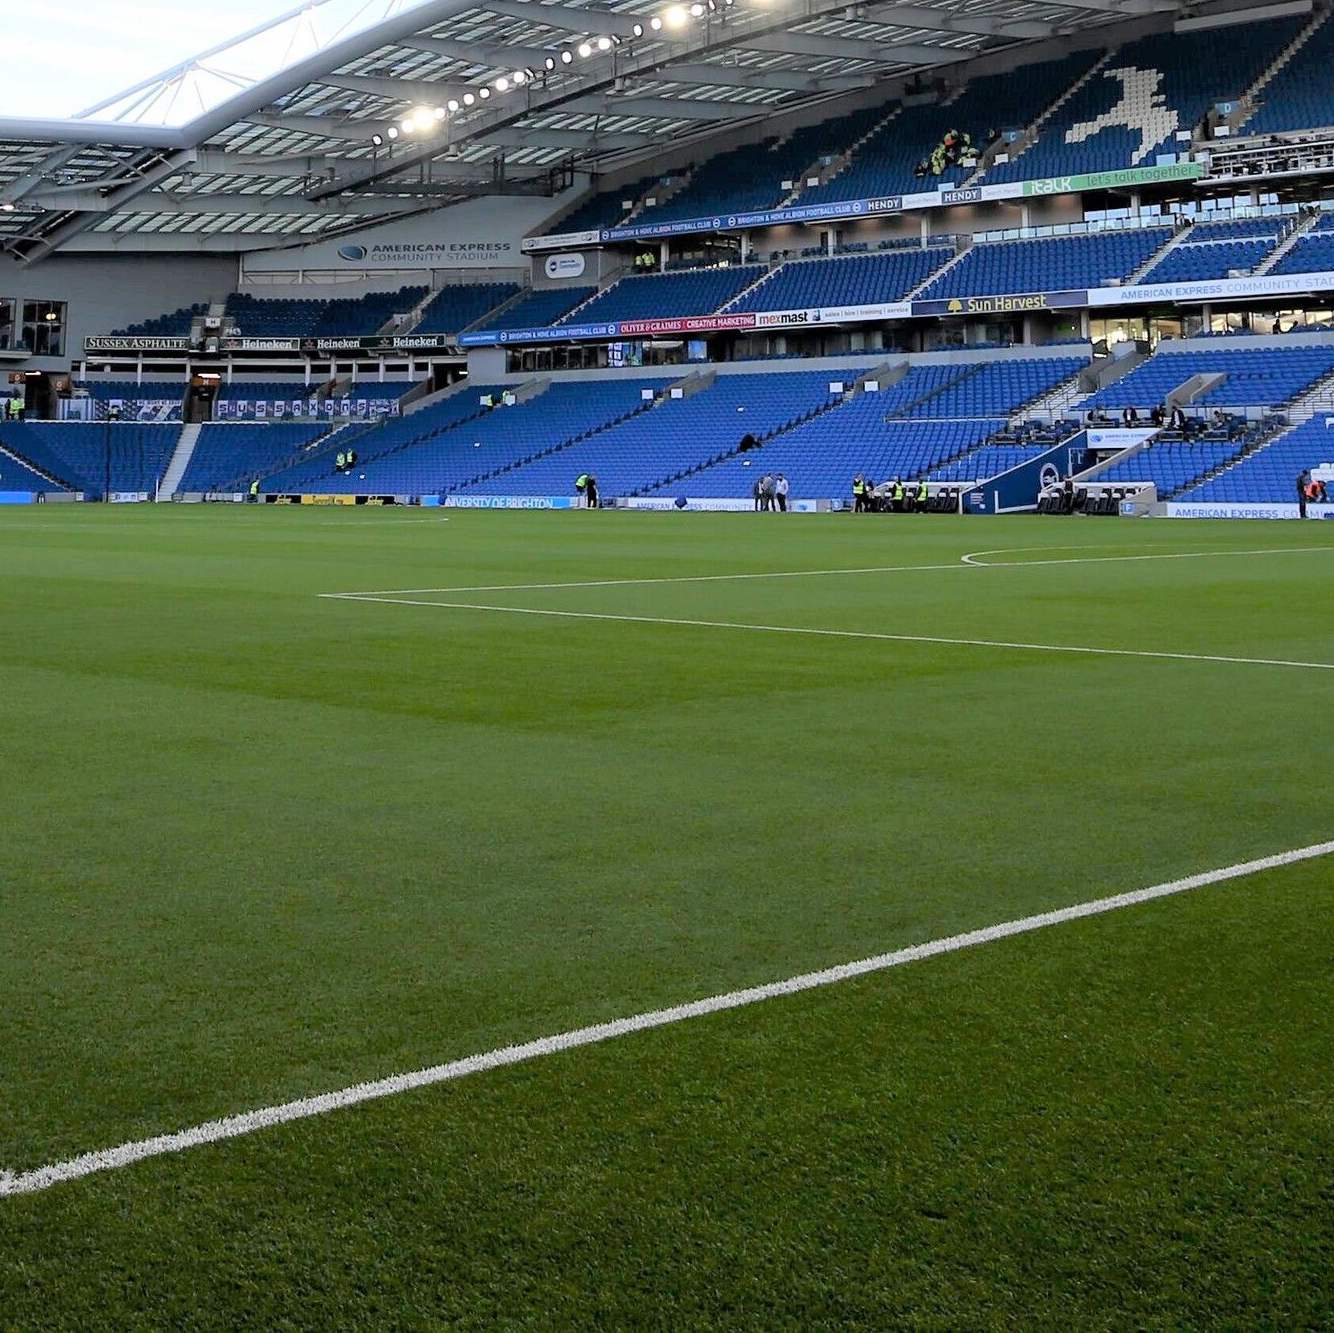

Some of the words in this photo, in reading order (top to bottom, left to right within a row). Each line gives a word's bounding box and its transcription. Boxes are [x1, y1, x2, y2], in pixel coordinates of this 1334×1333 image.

[1087, 174, 1111, 187] let's
[1115, 170, 1137, 184] talk
[1141, 165, 1193, 181] together
[944, 190, 978, 202] HENDY
[867, 199, 899, 211] HENDY
[737, 215, 764, 225] BRIGHTON
[786, 210, 806, 219] ALBION
[806, 207, 834, 216] FOOTBALL
[834, 204, 850, 213] CLUB
[371, 243, 446, 253] AMERICAN
[450, 242, 511, 252] EXPRESS
[371, 253, 442, 262] COMMUNITY
[446, 251, 499, 261] STADIUM
[1121, 287, 1173, 299] AMERICAN
[1175, 284, 1222, 296] EXPRESS
[1227, 279, 1300, 292] COMMUNITY
[968, 298, 992, 312] Sun
[995, 294, 1046, 310] Harvest
[686, 318, 717, 329] CREATIVE
[717, 315, 754, 327] MARKETING
[759, 311, 808, 325] mexmast
[621, 323, 644, 333] OLIVER
[89, 338, 129, 348] SUSSEX
[131, 338, 186, 348] ASPHALTE
[242, 339, 293, 349] Heineken
[317, 339, 360, 348] Heineken
[393, 337, 437, 347] Heineken
[507, 498, 554, 508] BRIGHTON
[1175, 509, 1229, 518] AMERICAN
[1231, 509, 1278, 518] EXPRESS
